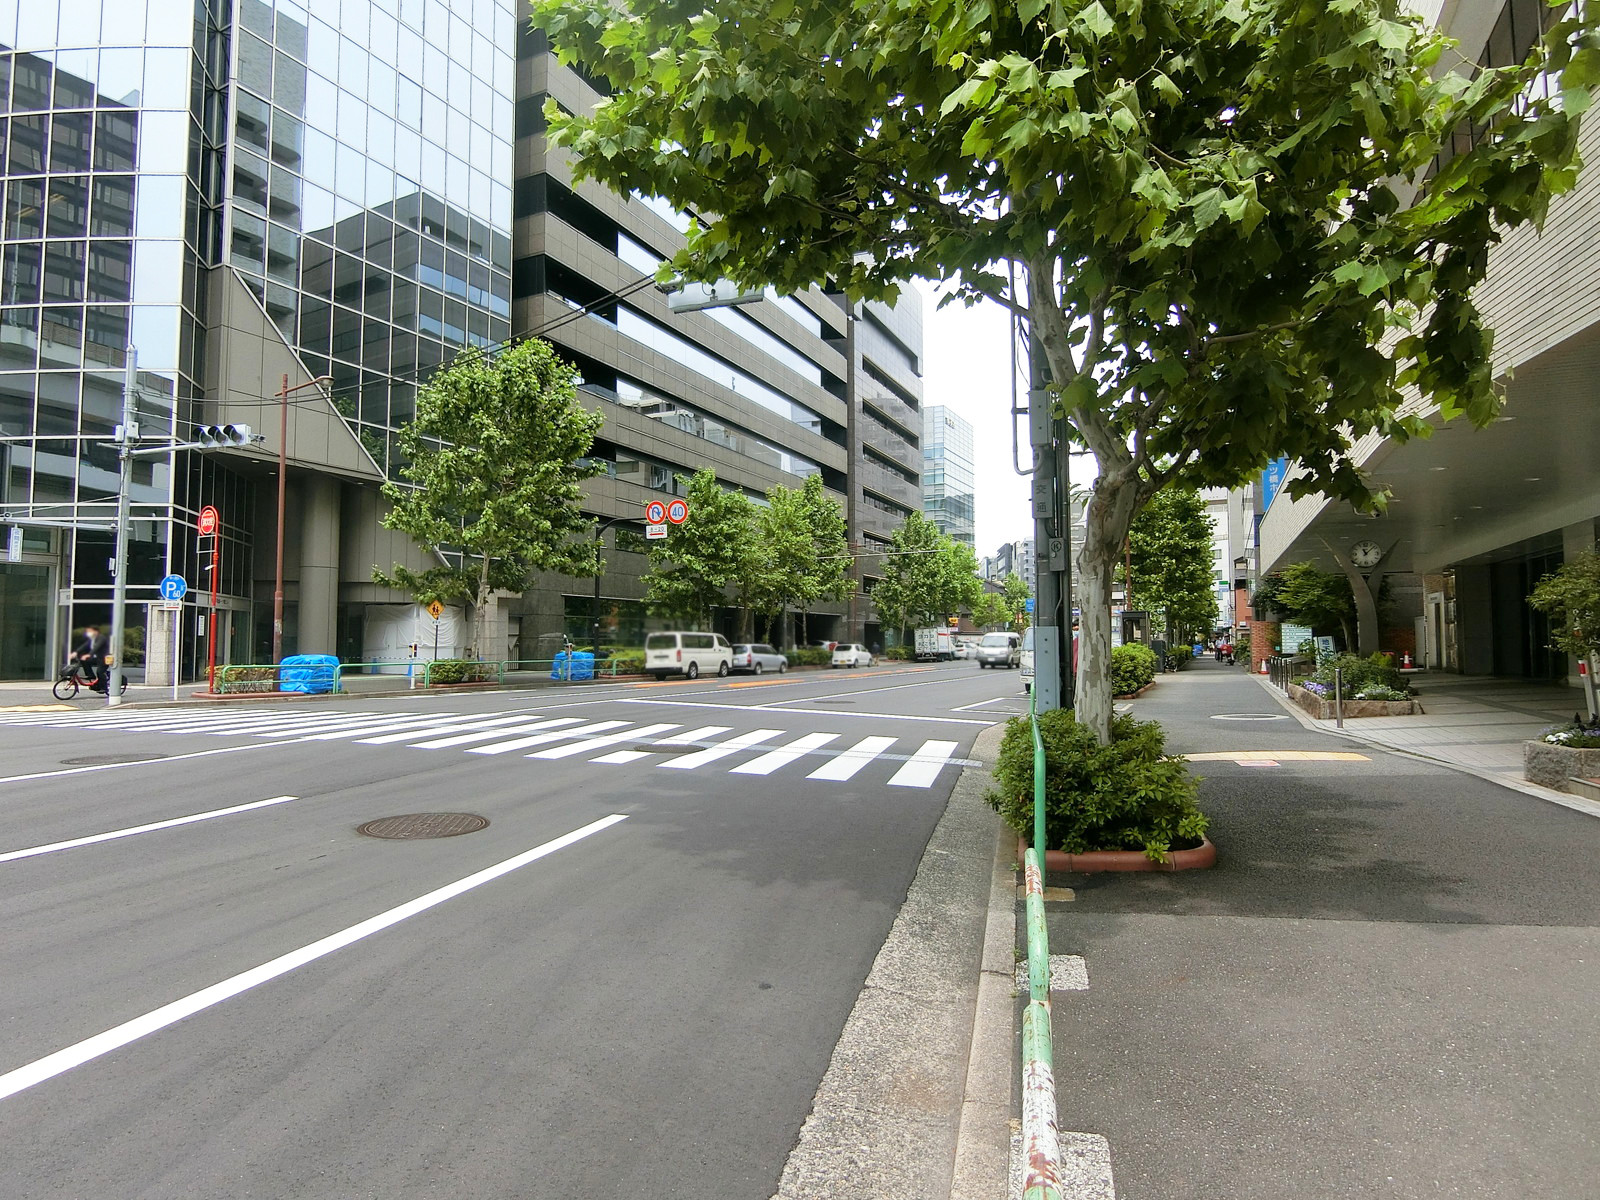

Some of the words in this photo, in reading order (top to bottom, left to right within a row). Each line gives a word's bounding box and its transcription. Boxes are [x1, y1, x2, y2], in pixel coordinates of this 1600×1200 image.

[1036, 484, 1047, 513] 交通
[672, 506, 684, 517] 40
[166, 581, 177, 598] P
[172, 590, 181, 598] 60
